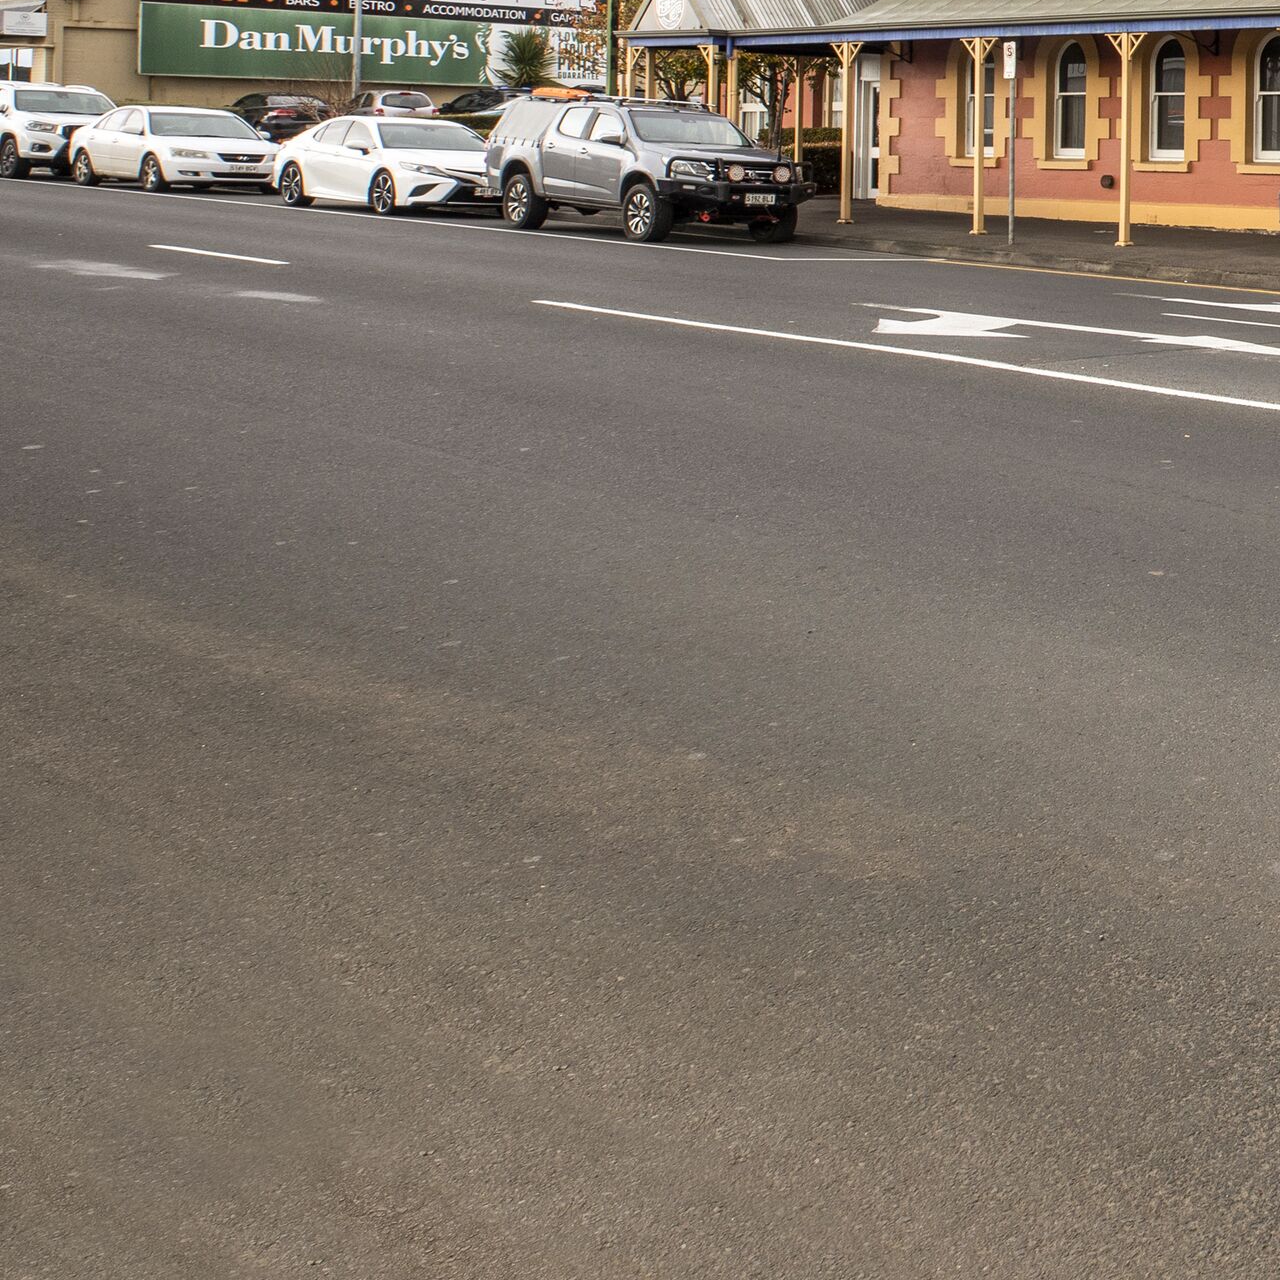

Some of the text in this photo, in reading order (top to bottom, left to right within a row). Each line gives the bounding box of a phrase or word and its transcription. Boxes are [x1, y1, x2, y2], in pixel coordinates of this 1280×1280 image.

[422, 4, 527, 20] ACCOMMODATION
[199, 18, 470, 67] Dan Murphy's
